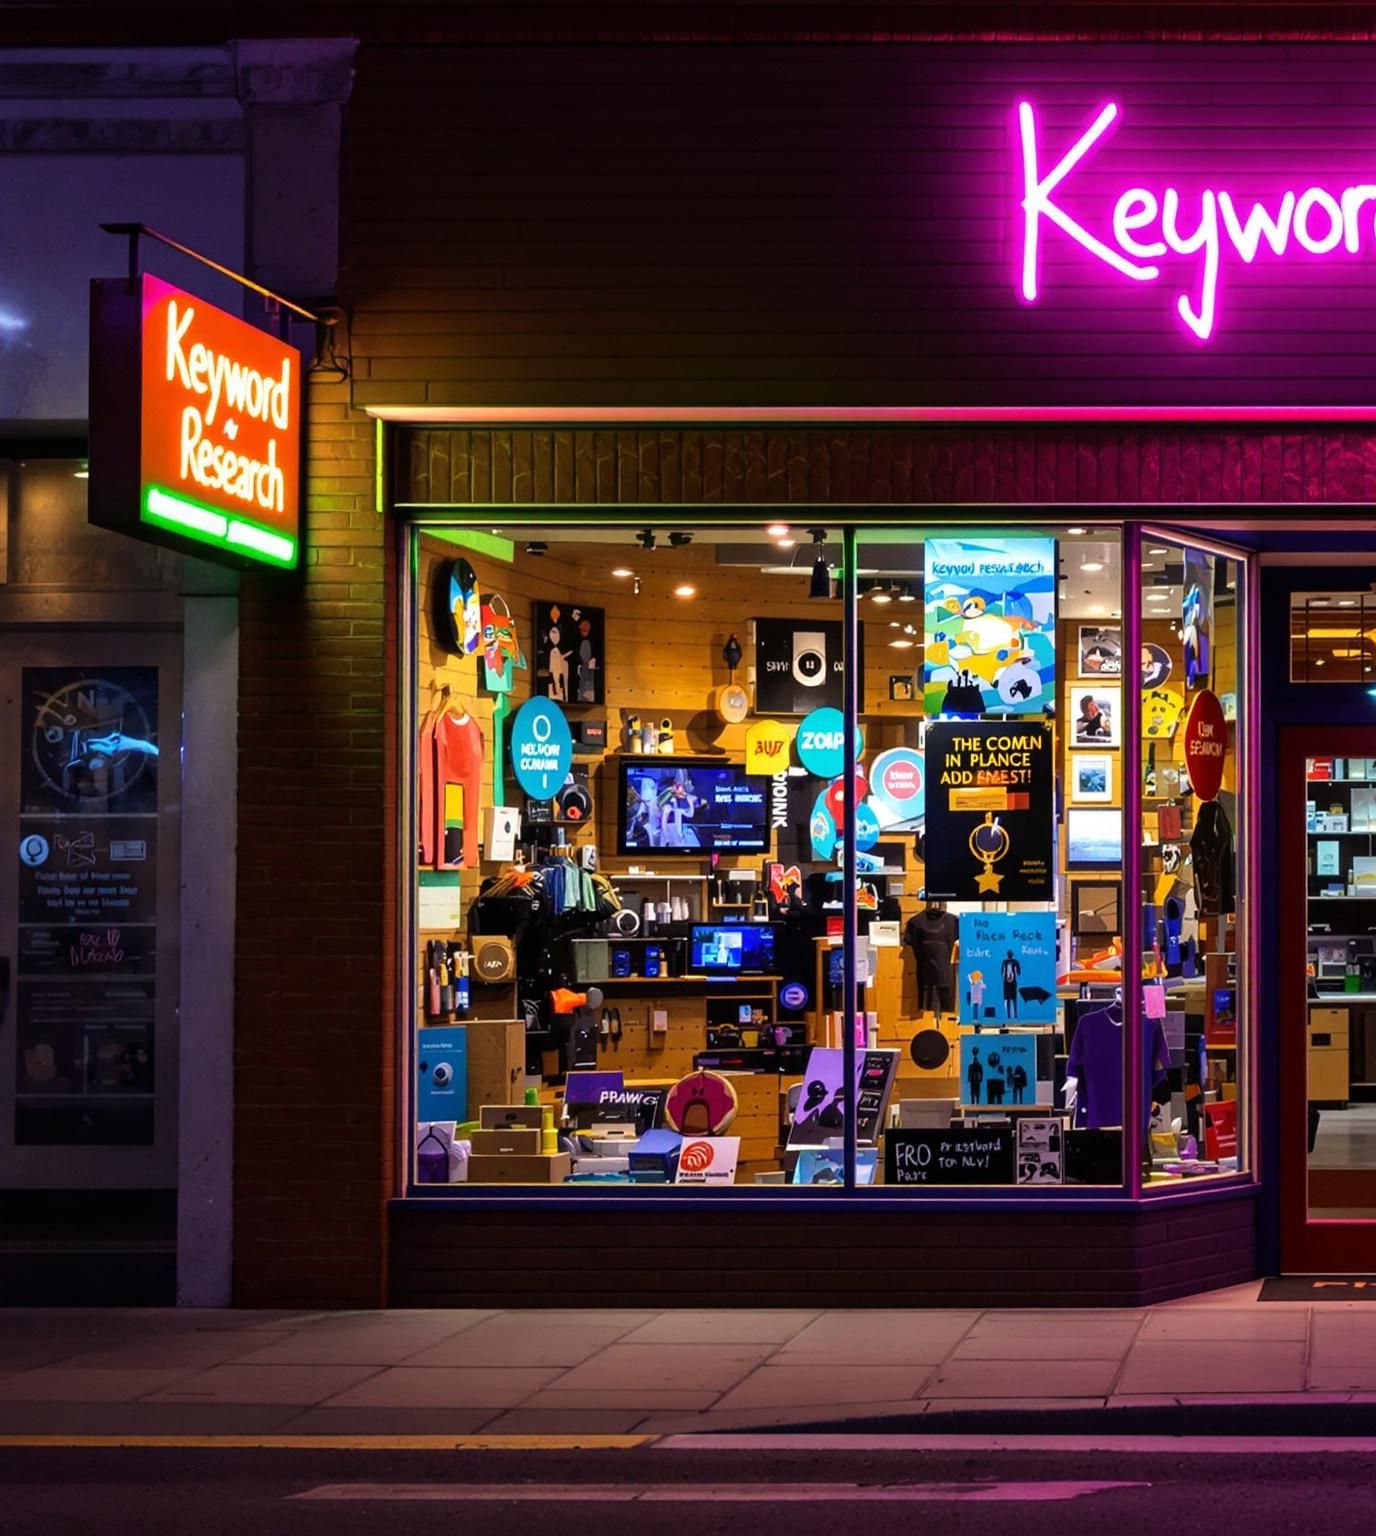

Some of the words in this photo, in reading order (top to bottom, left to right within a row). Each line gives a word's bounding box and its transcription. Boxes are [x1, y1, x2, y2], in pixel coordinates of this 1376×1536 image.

[165, 299, 291, 431] Keyword
[179, 405, 285, 513] Research
[952, 736, 982, 752] THE
[945, 753, 961, 768] IN
[969, 752, 1032, 767] PLANCE
[940, 770, 973, 785] ADD
[895, 1142, 932, 1167] FRO
